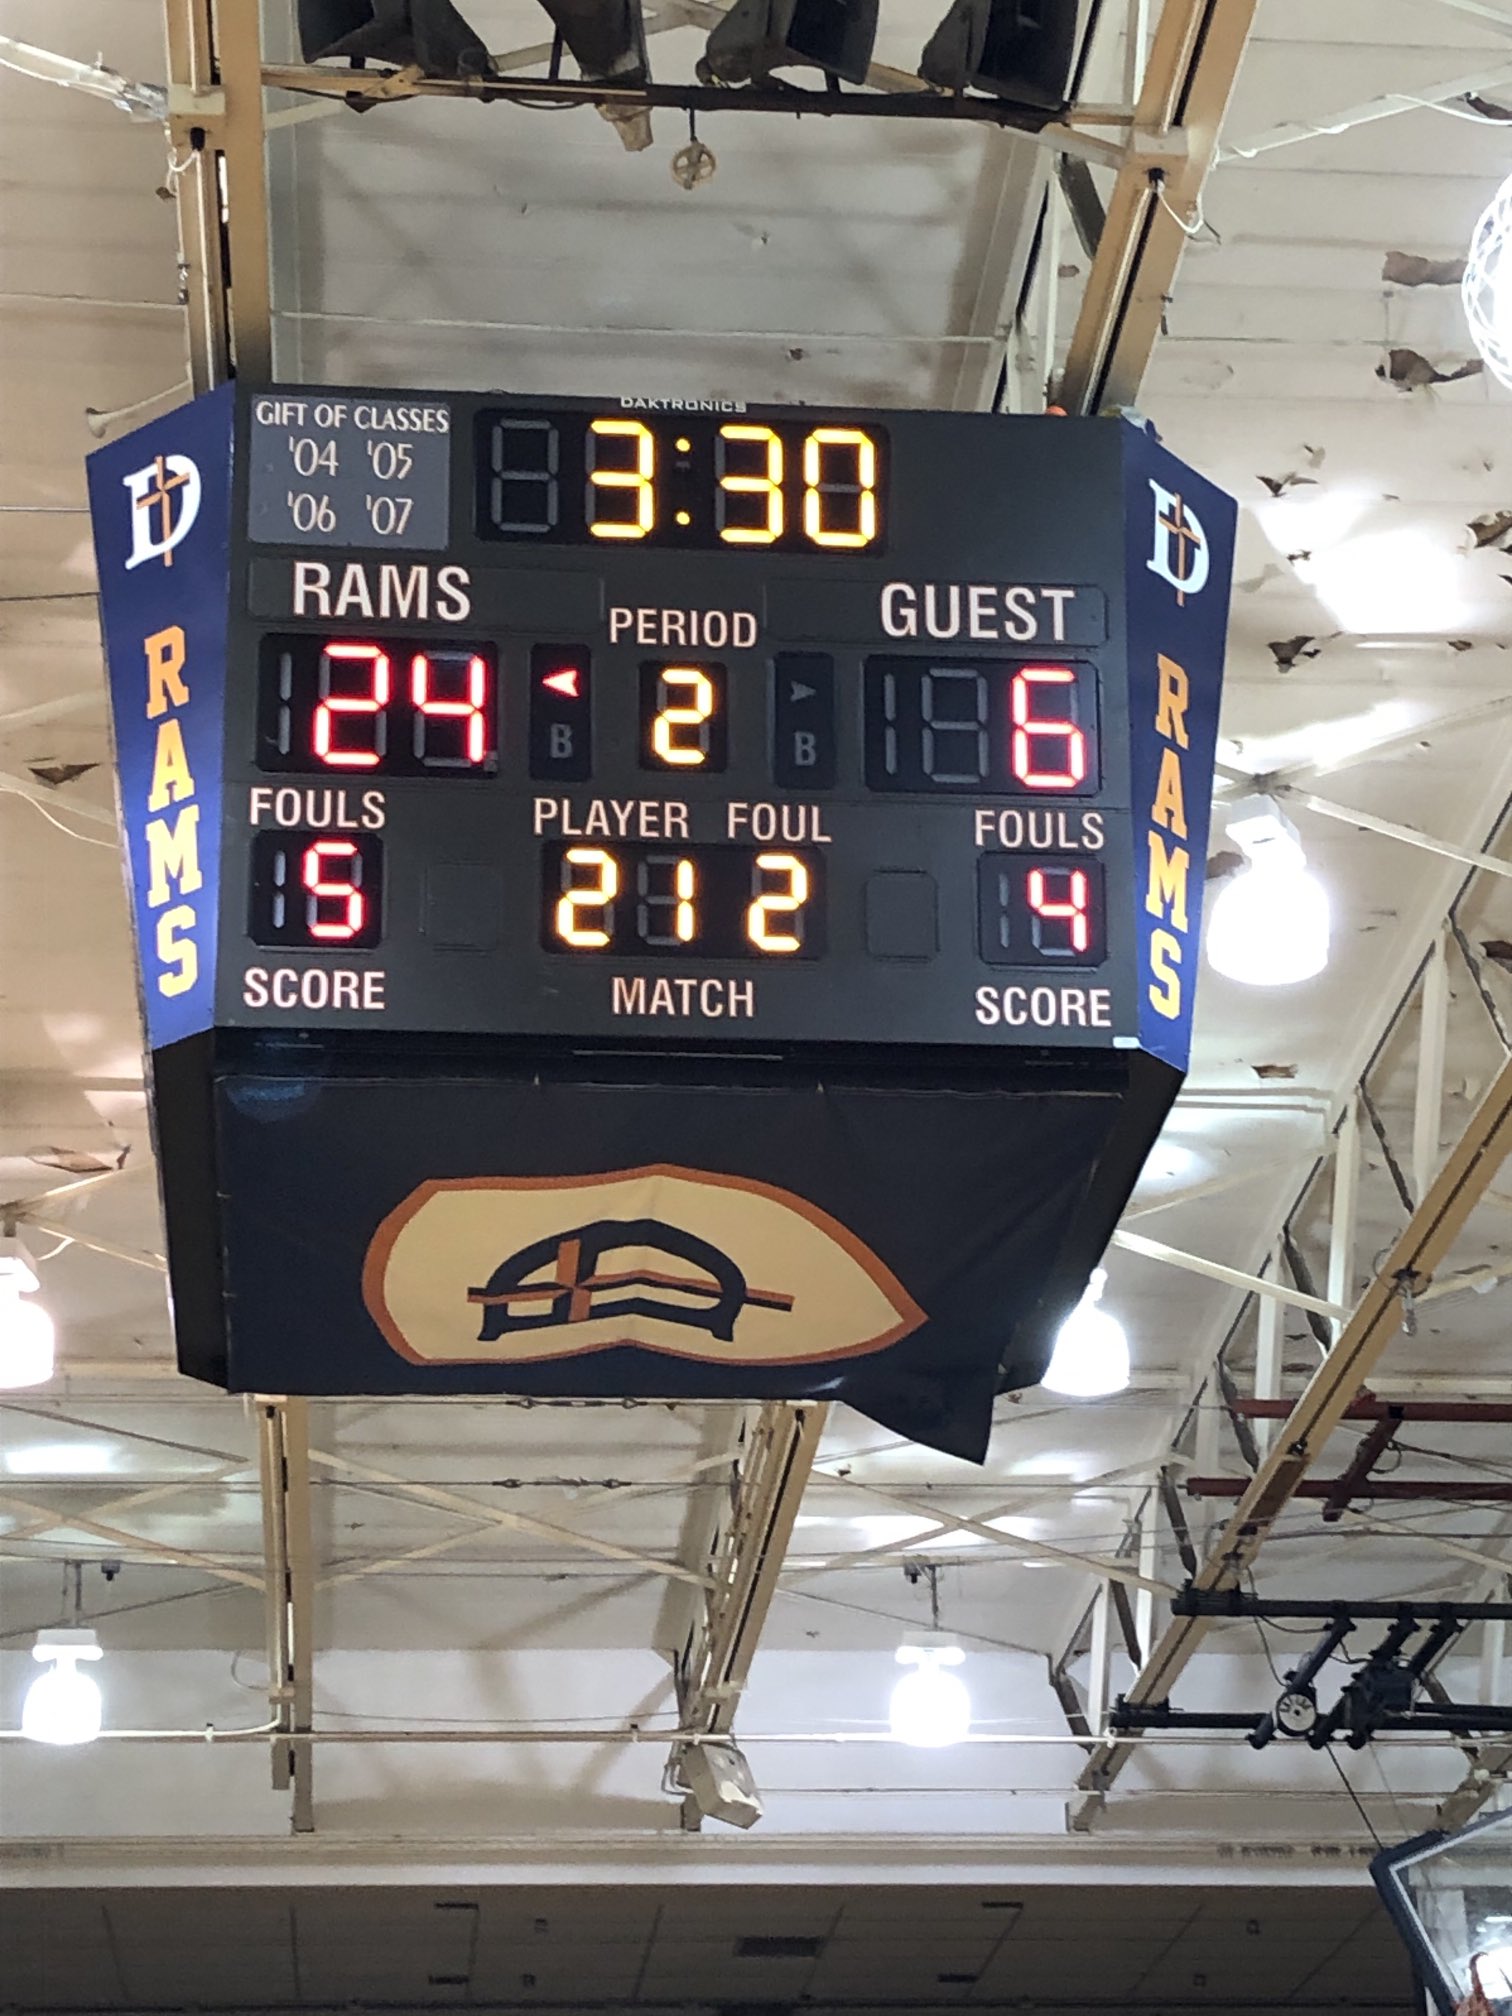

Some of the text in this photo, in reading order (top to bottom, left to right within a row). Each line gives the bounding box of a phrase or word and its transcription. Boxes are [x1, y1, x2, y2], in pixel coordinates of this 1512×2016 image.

[256, 401, 449, 433] GIFT OF CLASSES
[620, 396, 747, 413] DAKTRONICS
[289, 436, 413, 480] '04 '05
[590, 420, 875, 547] 3:30
[287, 491, 414, 535] '06 '07
[293, 562, 470, 621] RAMS
[881, 582, 1074, 641] GUEST
[609, 607, 757, 648] PERIOD
[314, 644, 485, 766] 24
[654, 668, 713, 764] 2
[1011, 667, 1084, 788] 6
[144, 625, 203, 998] RAMS
[250, 788, 385, 828] FOULS
[533, 797, 832, 843] PLAYER FOUL
[975, 810, 1104, 849] FOULS
[1144, 653, 1189, 1020] RAMS
[305, 842, 362, 938] 5
[748, 855, 807, 951] 2
[1028, 868, 1086, 951] 4
[243, 968, 385, 1010] SCORE
[611, 976, 754, 1018] MATCH
[975, 987, 1111, 1027] SCORE
